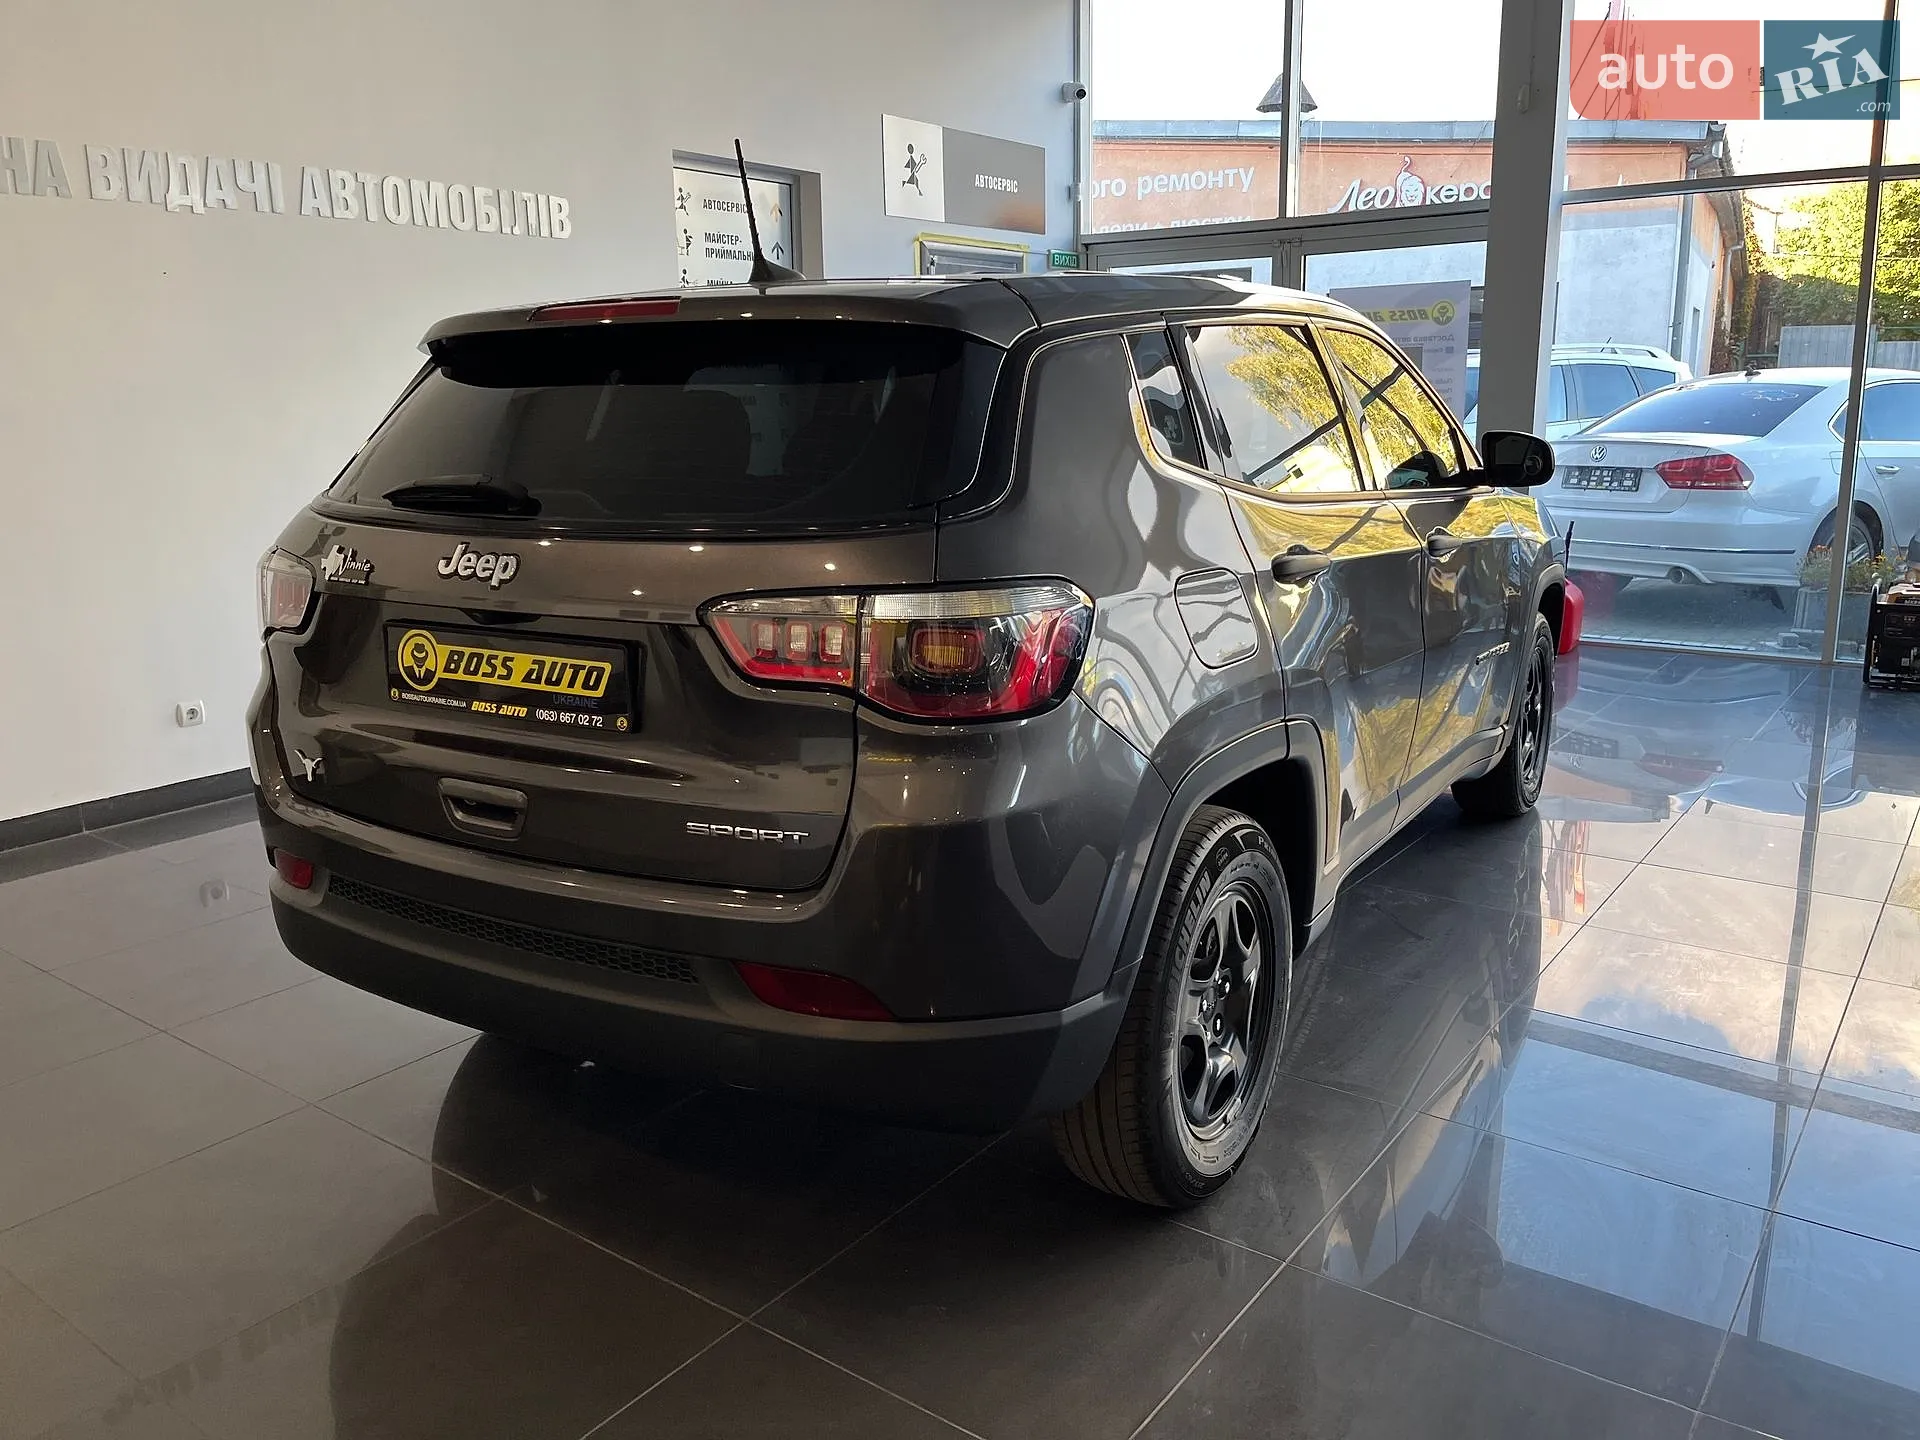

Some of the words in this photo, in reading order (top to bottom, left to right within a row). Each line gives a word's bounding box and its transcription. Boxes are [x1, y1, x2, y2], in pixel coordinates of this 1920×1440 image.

[86, 143, 285, 214] ВИДАЧІ
[974, 174, 1018, 193] АВТОСЕРВІС
[1137, 166, 1255, 200] ремонту
[1327, 178, 1395, 213] Лео
[704, 231, 742, 245] МАЙСТЕР-
[1053, 254, 1078, 267] ВИХІД
[437, 541, 519, 588] Jeep
[442, 649, 514, 681] BOSS
[520, 659, 606, 692] AUTO
[471, 700, 498, 714] BOSS
[498, 704, 528, 718] AUTO
[535, 708, 558, 722] (063)
[559, 711, 577, 724] 667
[577, 713, 590, 726] 02
[591, 715, 604, 727] 72
[552, 693, 600, 709] UKRAINE
[686, 821, 810, 844] SPORT
